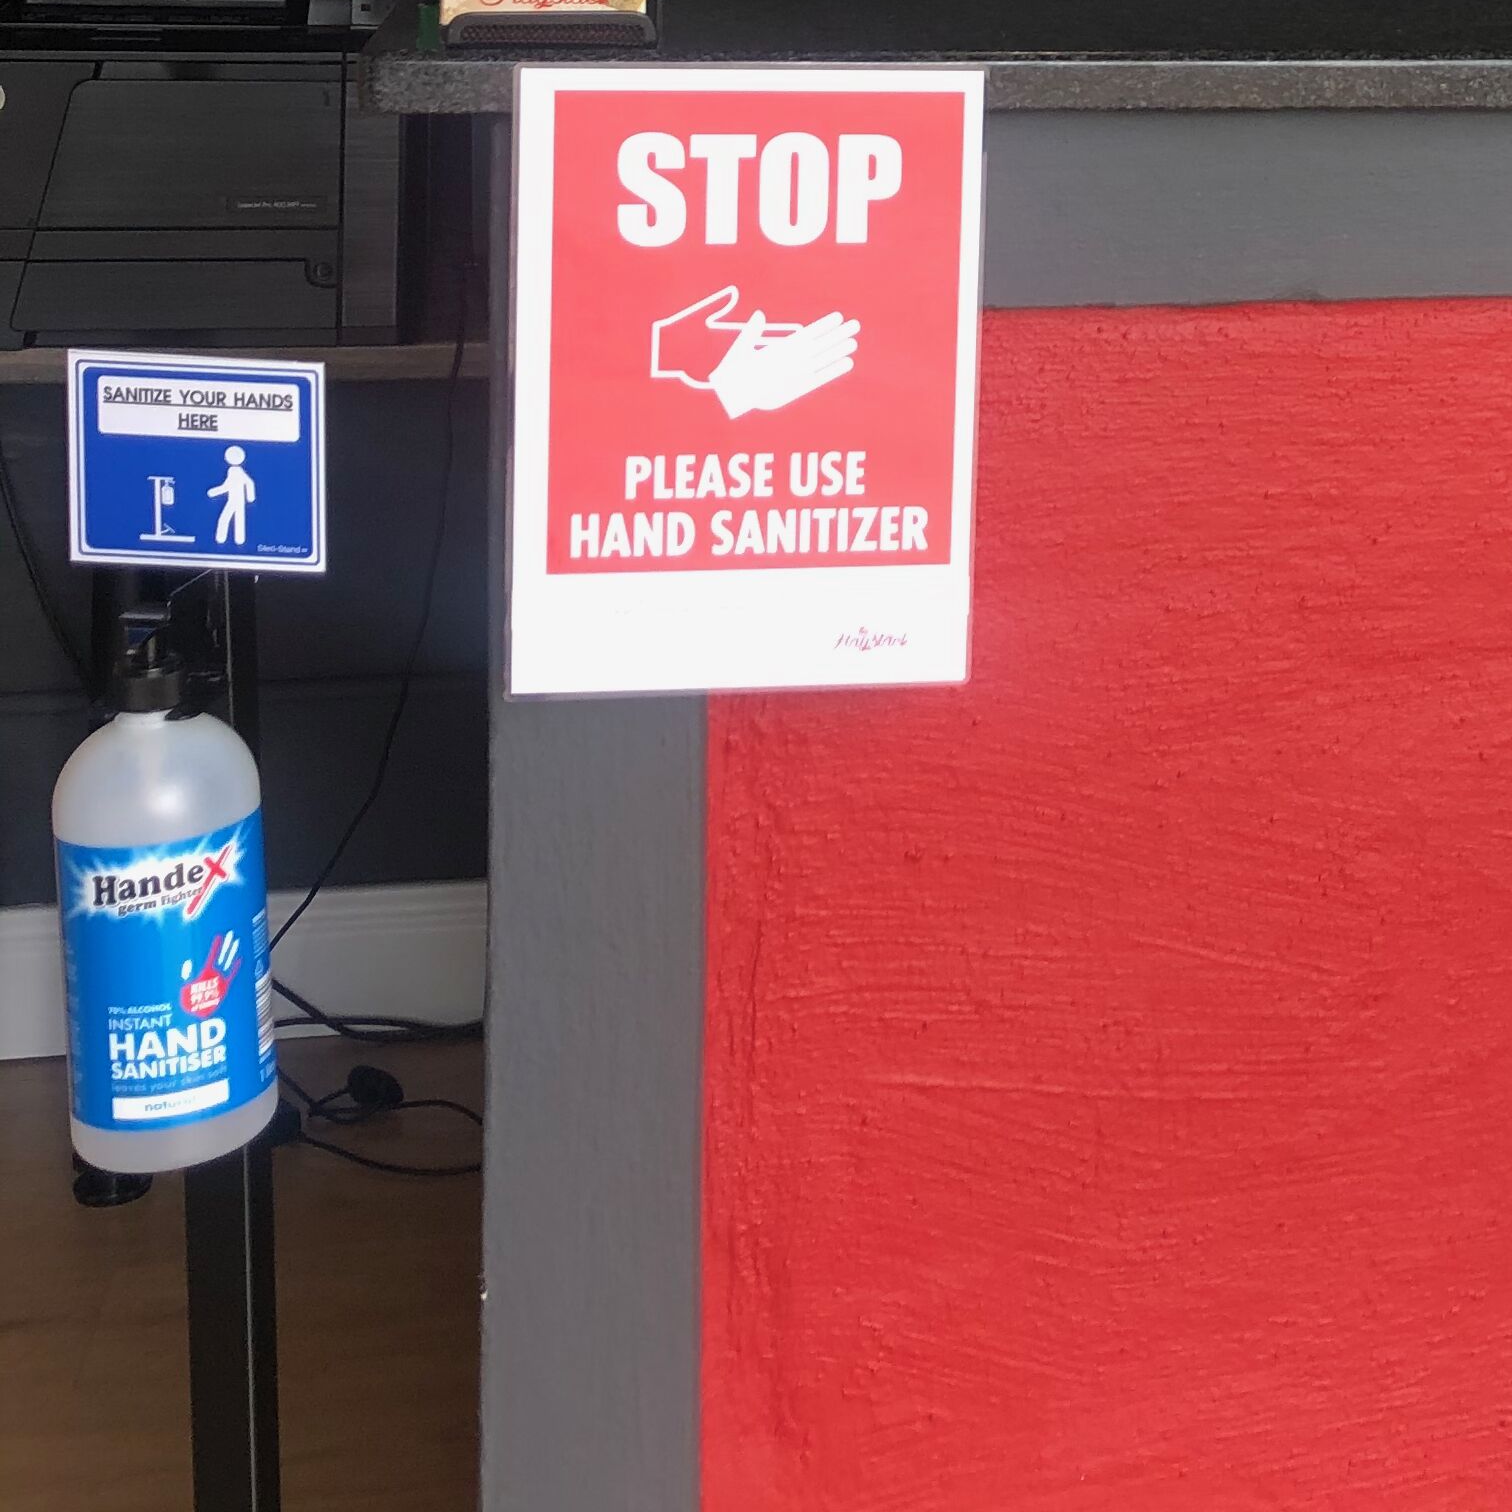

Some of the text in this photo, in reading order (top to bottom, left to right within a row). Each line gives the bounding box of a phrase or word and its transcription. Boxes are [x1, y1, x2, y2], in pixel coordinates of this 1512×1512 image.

[616, 131, 903, 248] STOP
[103, 385, 293, 410] SANITIZE YOUR HANDS
[178, 413, 219, 431] HERE
[624, 450, 866, 501] PLEASE USE
[569, 506, 929, 560] HAND SANITIZER
[118, 886, 204, 917] germ fighter
[191, 976, 219, 994] KILLS
[108, 1014, 173, 1031] INSTANT
[109, 1017, 226, 1060] HAND
[111, 1045, 226, 1080] SANITISER
